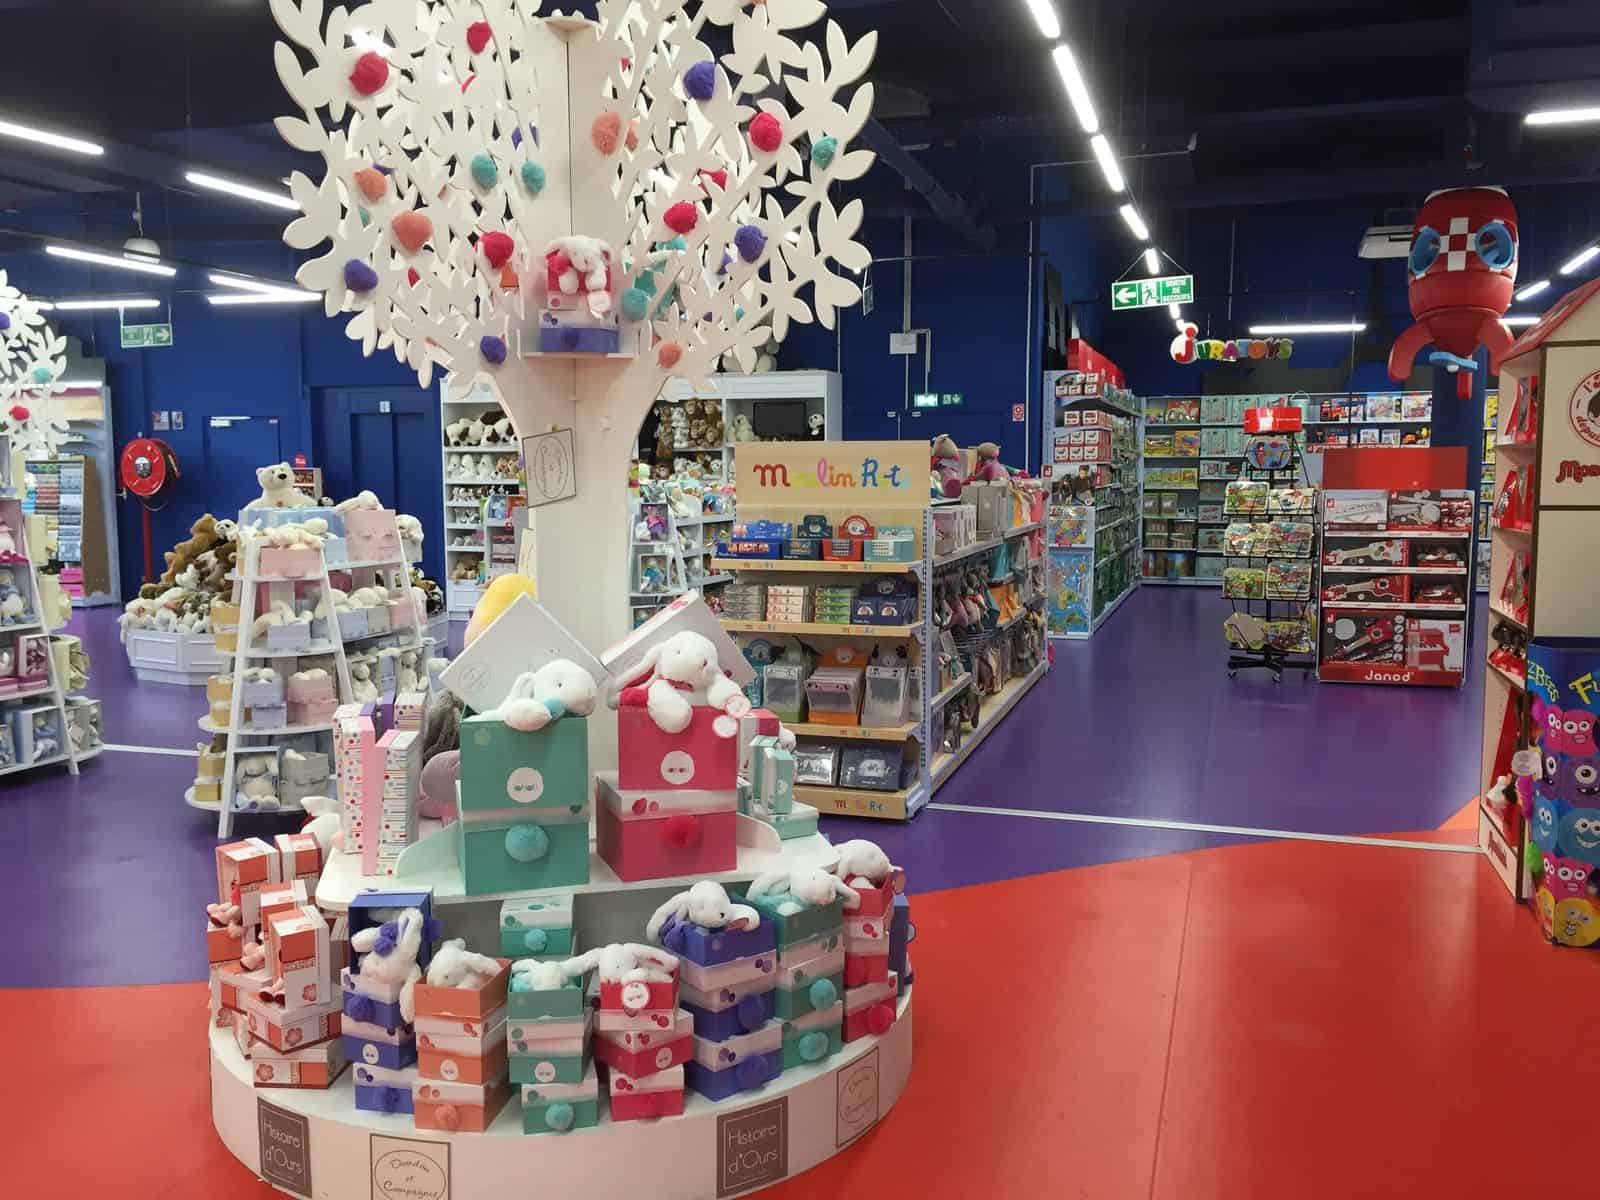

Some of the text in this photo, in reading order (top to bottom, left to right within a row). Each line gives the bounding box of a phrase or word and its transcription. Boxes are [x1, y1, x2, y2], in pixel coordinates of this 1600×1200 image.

[1364, 669, 1411, 682] Janod
[265, 1145, 302, 1174] d'Ours
[728, 1150, 777, 1174] d'Ours
